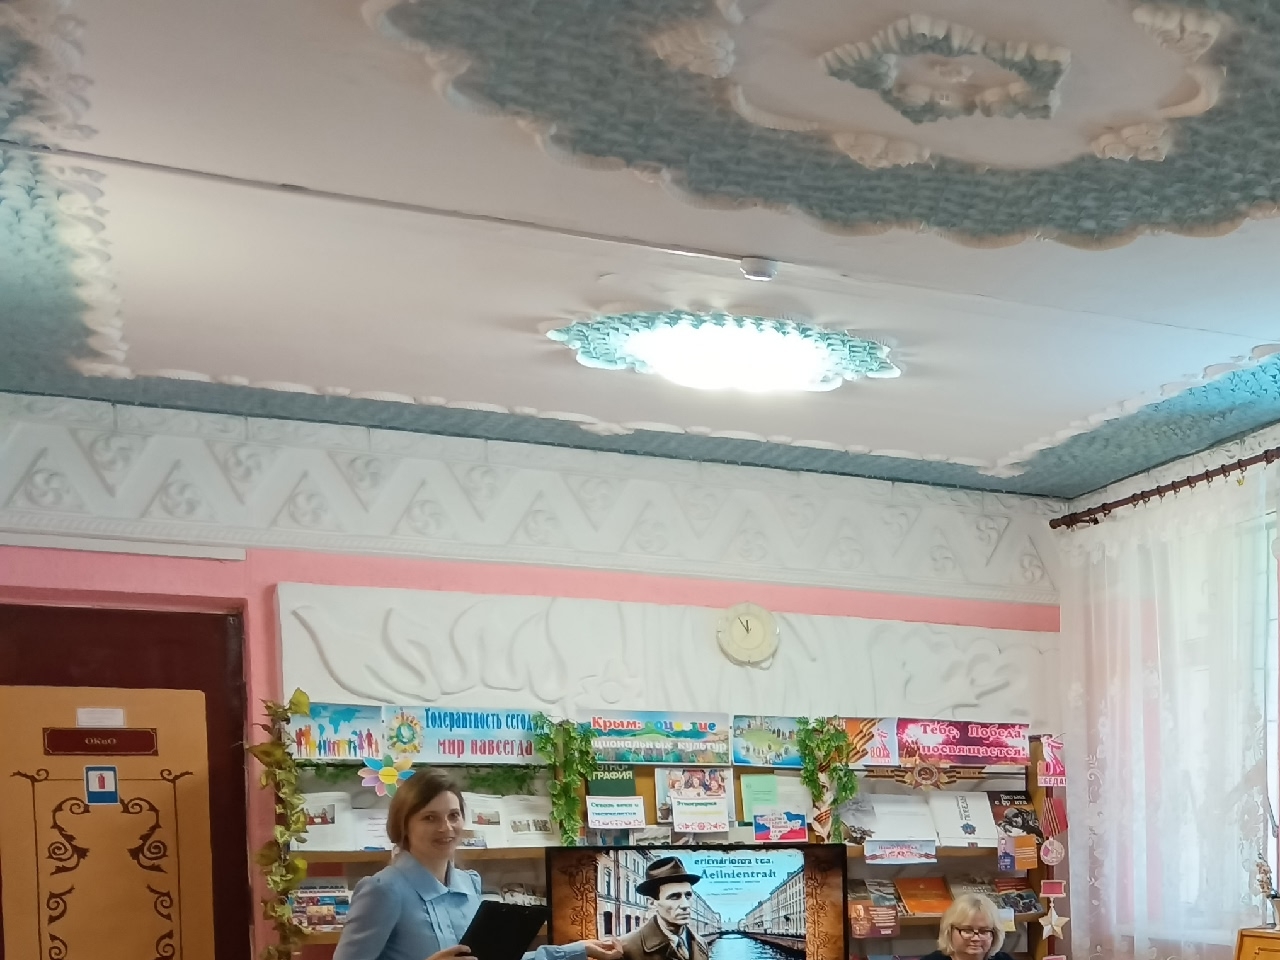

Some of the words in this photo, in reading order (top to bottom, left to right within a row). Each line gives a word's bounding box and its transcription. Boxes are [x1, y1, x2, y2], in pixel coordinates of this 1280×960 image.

[425, 708, 502, 731] Толерантность
[506, 713, 534, 731] сегод
[592, 717, 641, 731] Крым:
[920, 724, 960, 738] Тебе,
[969, 725, 1026, 738] Победа,
[437, 738, 465, 758] мир
[471, 739, 533, 757] навсегда
[677, 741, 727, 752] культур
[920, 746, 1026, 757] посвящается!
[592, 771, 633, 780] ГРАФИЯ
